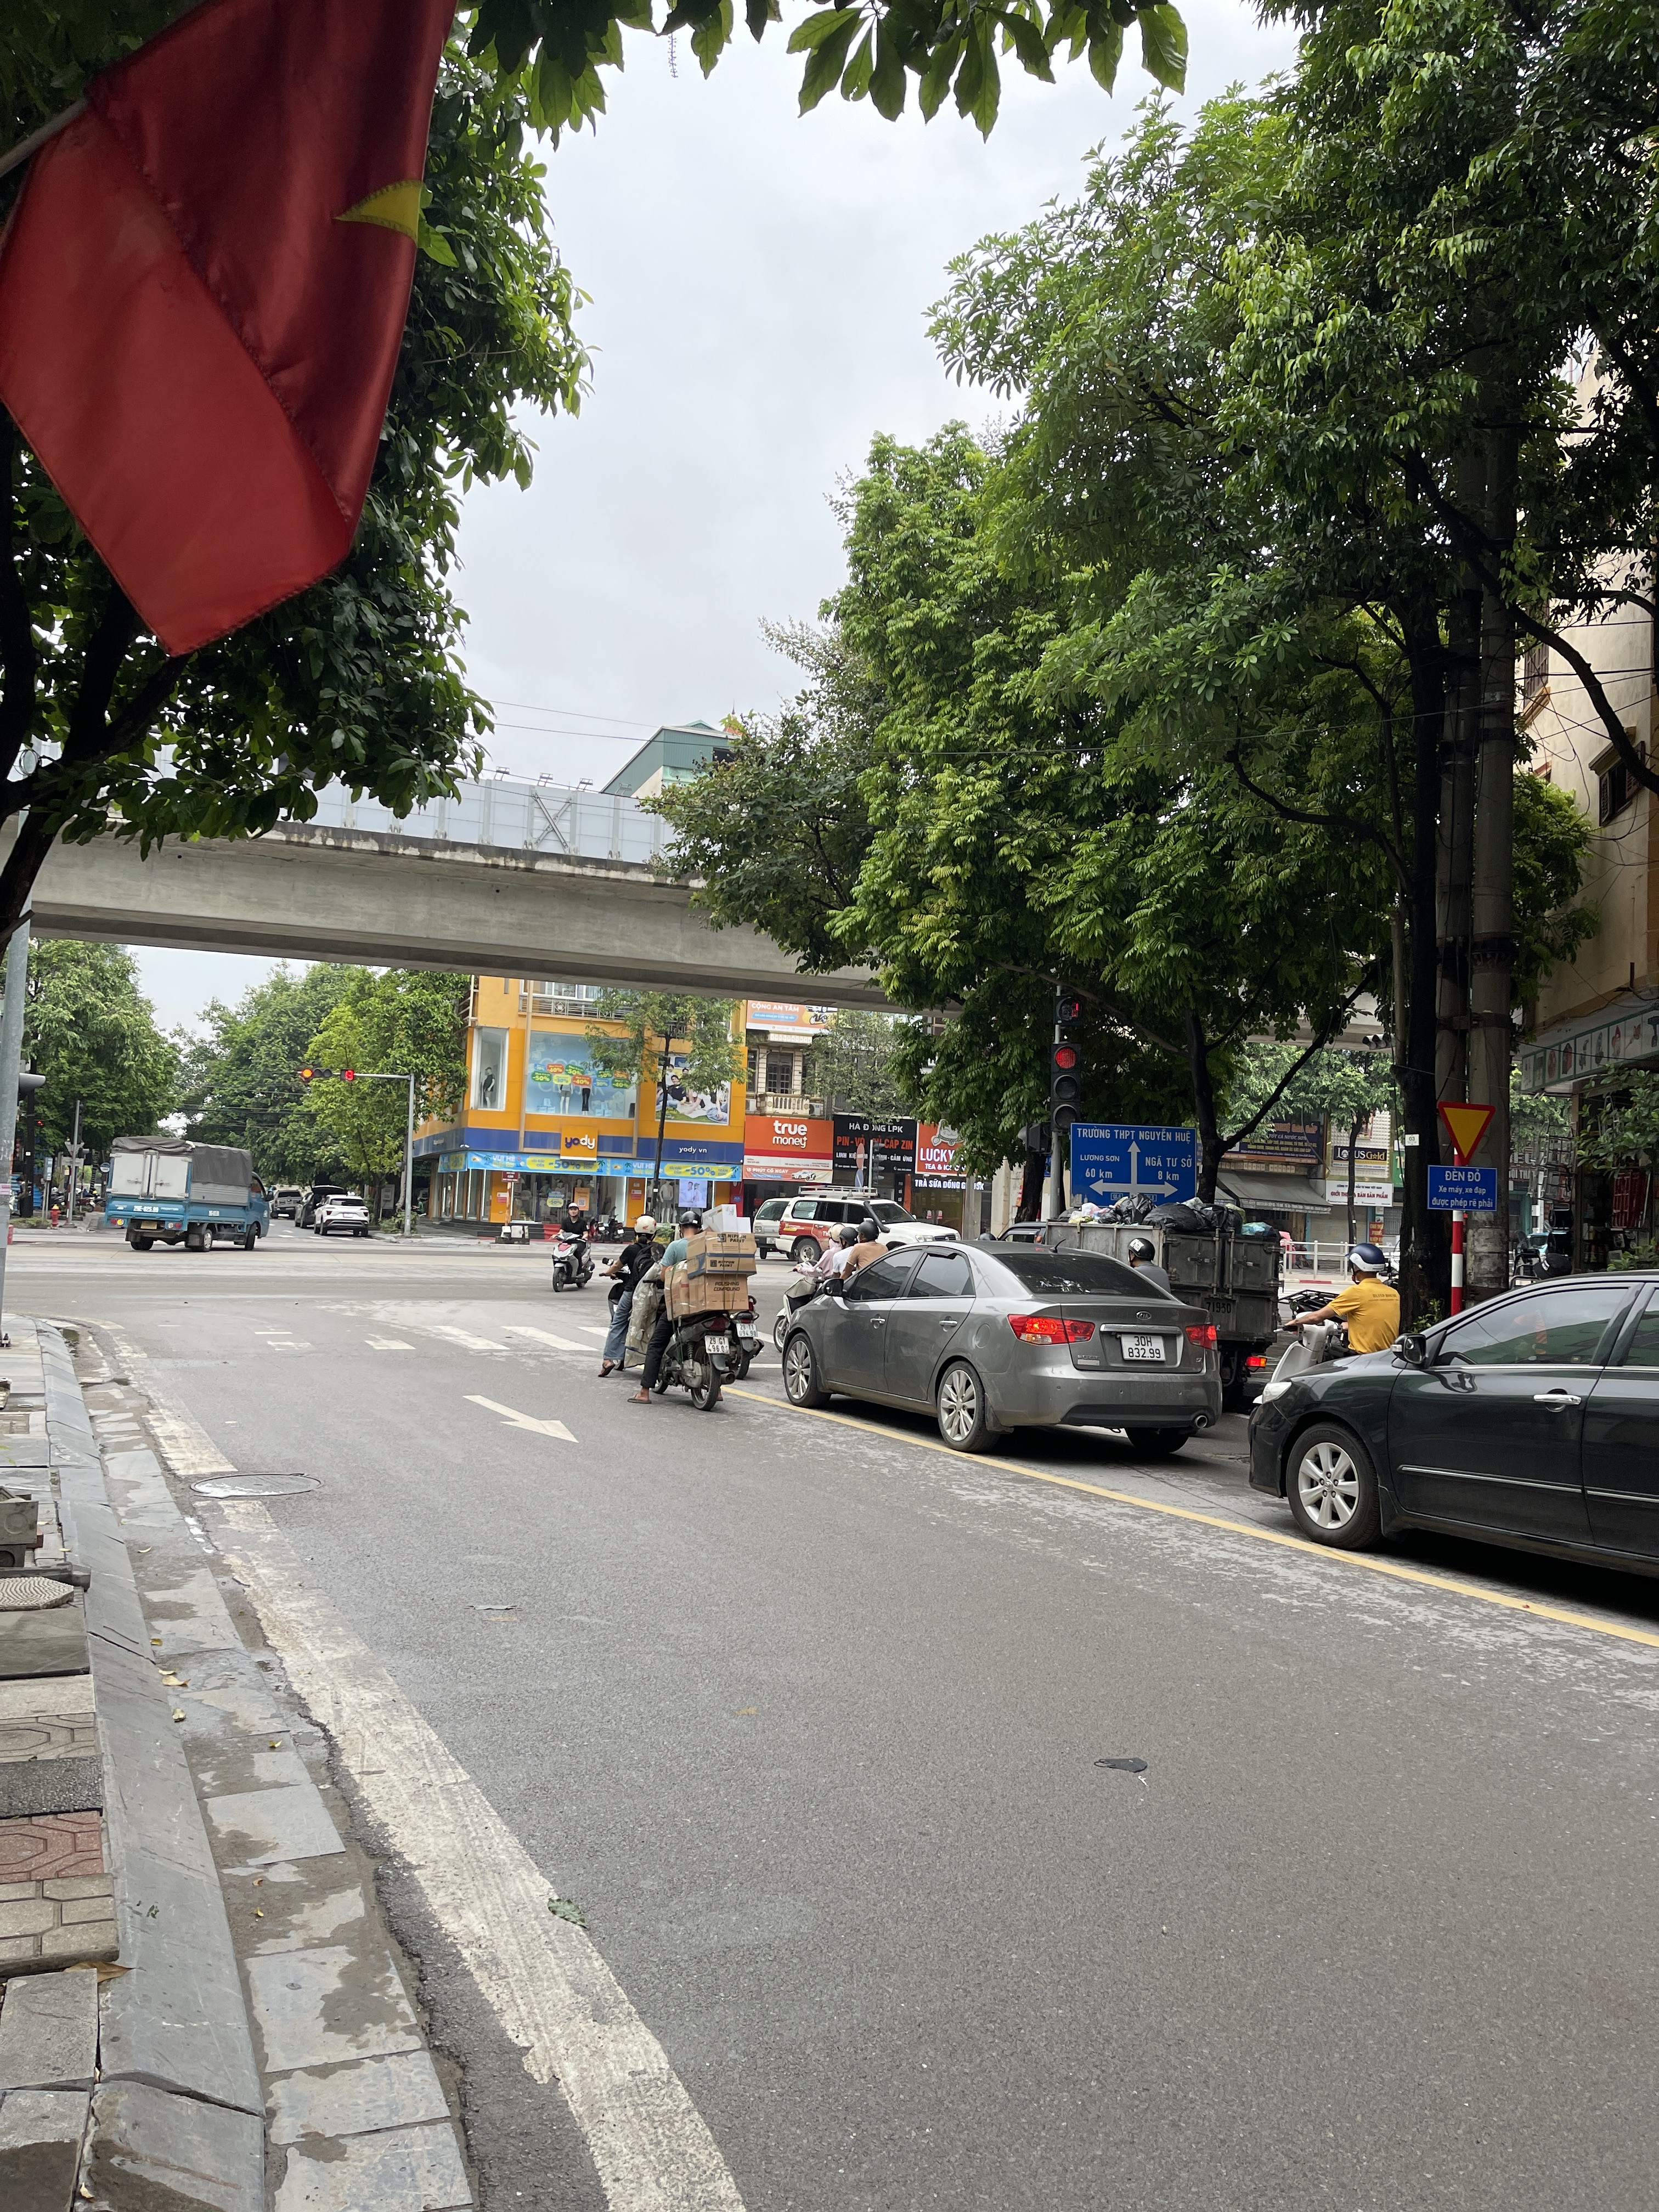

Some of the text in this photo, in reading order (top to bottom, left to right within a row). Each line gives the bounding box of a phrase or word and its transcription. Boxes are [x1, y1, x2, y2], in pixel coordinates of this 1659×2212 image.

[751, 1002, 771, 1011] CỘNG
[774, 1120, 808, 1136] true
[849, 1122, 861, 1131] HÀ
[1077, 1126, 1192, 1144] TRƯỜNG THPT NGUYỄN HUỆ
[565, 1135, 596, 1149] yody
[772, 1136, 808, 1149] money
[837, 1136, 850, 1147] PIN
[901, 1140, 913, 1150] ZIN
[679, 1146, 697, 1154] yody
[920, 1148, 955, 1163] LUCKY
[1145, 1155, 1193, 1168] NGÃ TƯ SỞ
[685, 1166, 716, 1176] -50%
[1085, 1168, 1113, 1179] 60 km
[1158, 1170, 1180, 1181] 8 km
[1444, 1168, 1481, 1182] ĐÈN ĐỎ
[915, 1178, 928, 1187] TRÀ
[929, 1178, 942, 1188] SỮA
[1474, 1186, 1486, 1195] đạp
[1432, 1197, 1449, 1207] được
[1450, 1198, 1468, 1208] phép
[1478, 1198, 1493, 1209] phải
[1133, 1336, 1153, 1347] 30H
[1128, 1347, 1161, 1359] 832.99
